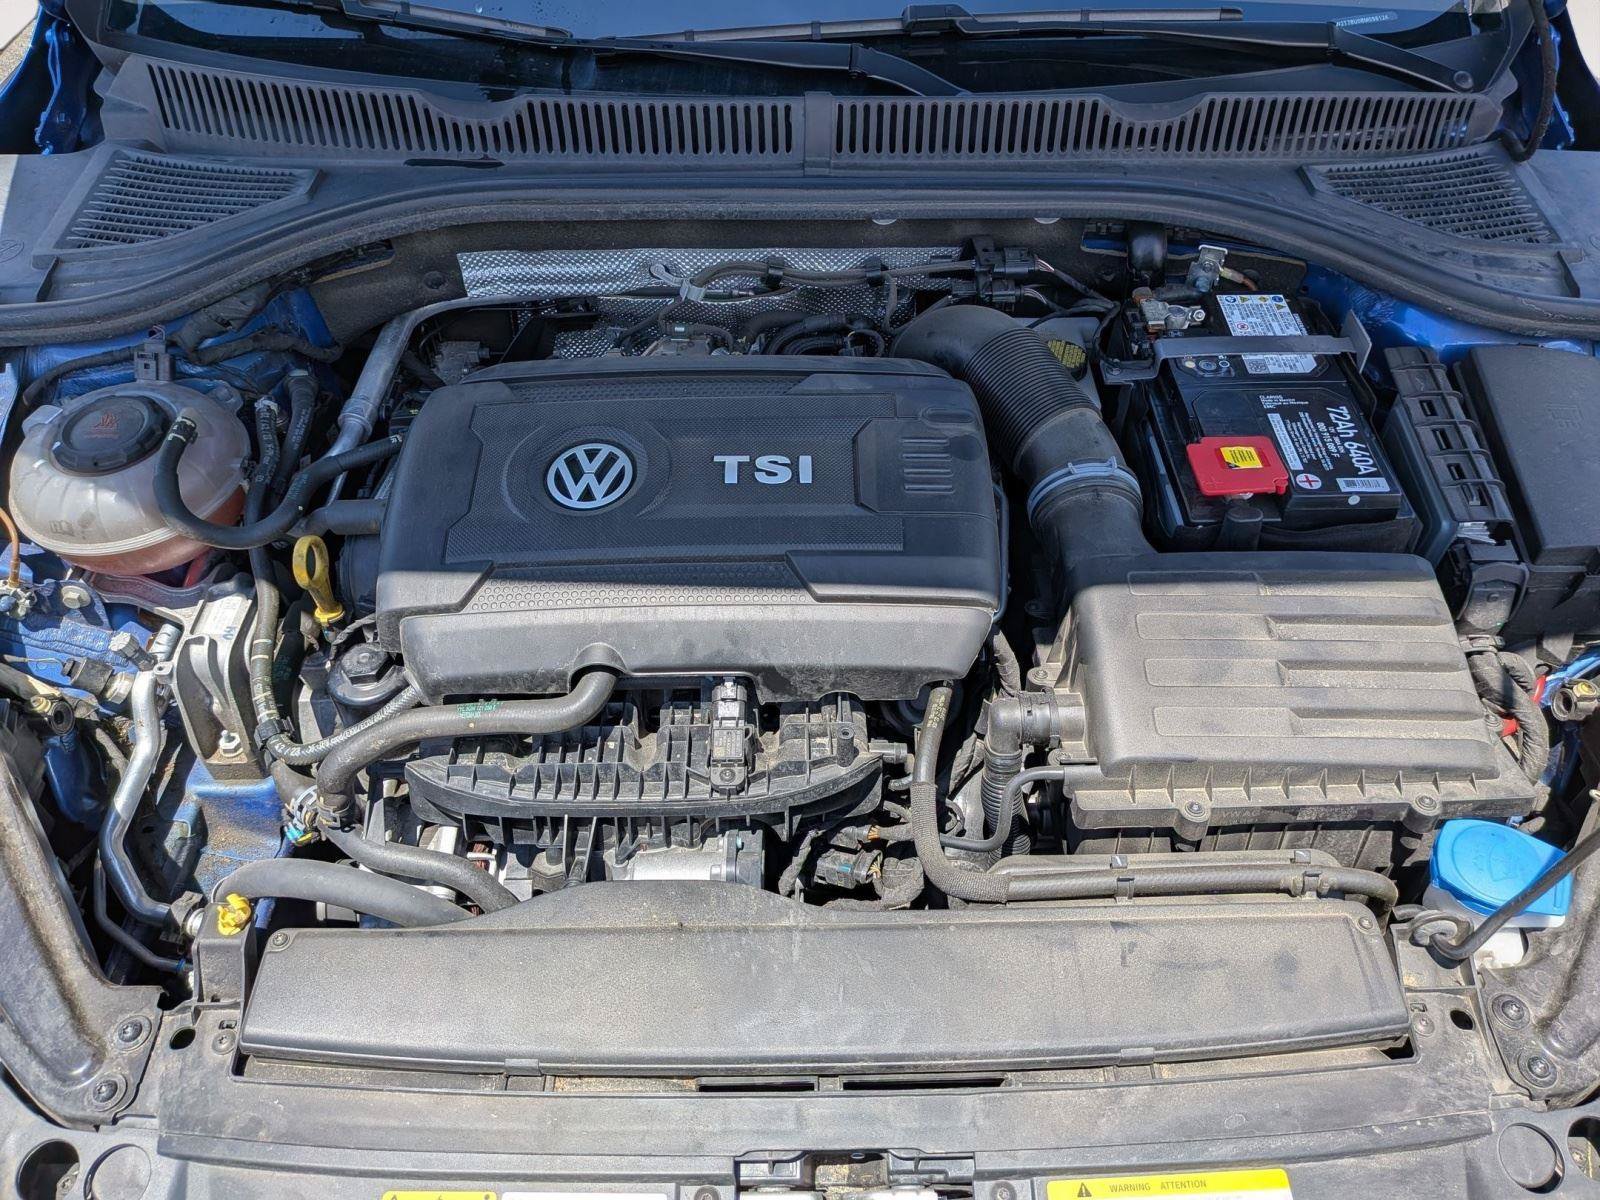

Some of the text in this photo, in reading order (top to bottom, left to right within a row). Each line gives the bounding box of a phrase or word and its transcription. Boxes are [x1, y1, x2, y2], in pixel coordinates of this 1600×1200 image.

[1326, 405, 1359, 438] 72Ah
[1343, 441, 1377, 475] 640A
[713, 455, 812, 484] TSI
[1109, 1179, 1207, 1193] WARNING ATTENTION
